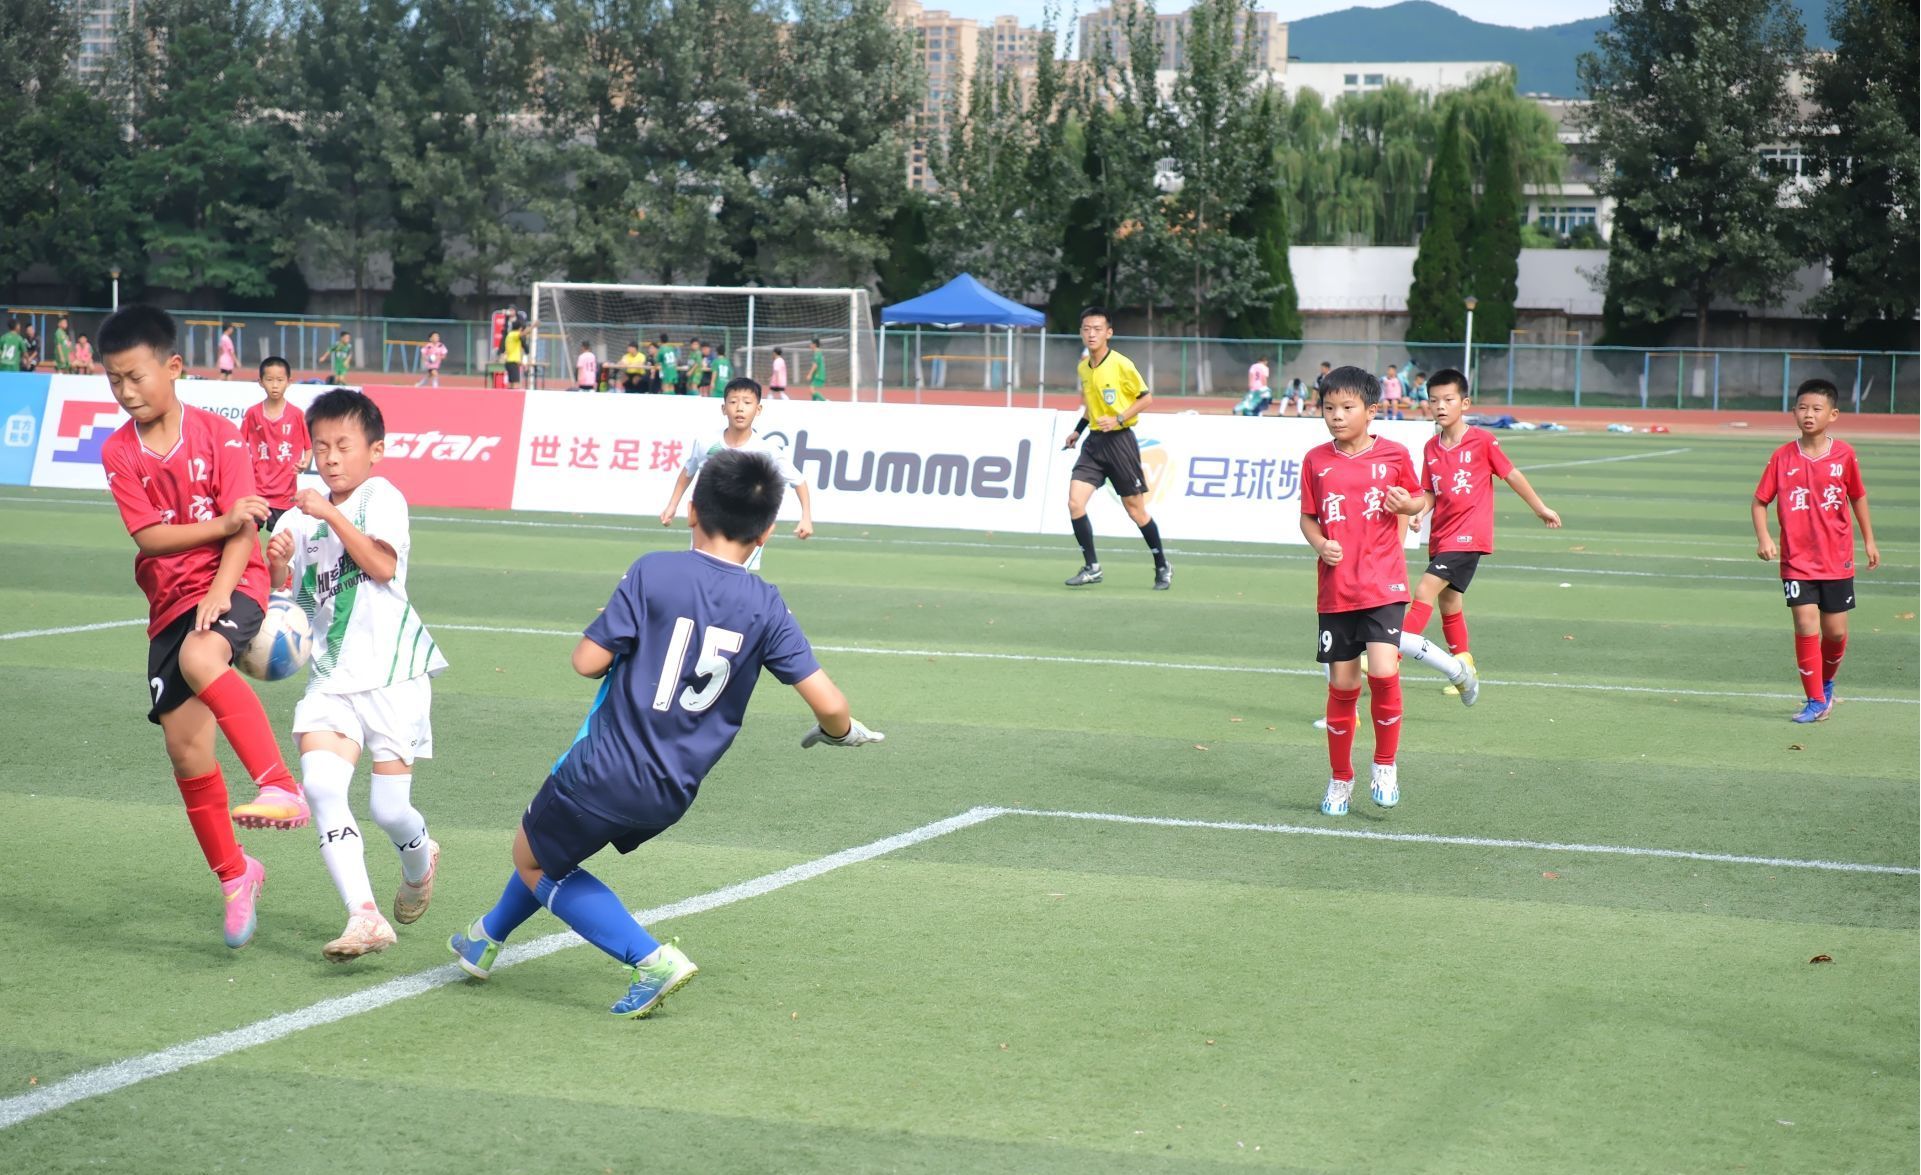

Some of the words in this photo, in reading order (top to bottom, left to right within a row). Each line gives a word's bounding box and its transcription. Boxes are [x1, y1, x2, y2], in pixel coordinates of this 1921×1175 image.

[282, 424, 292, 435] 17
[258, 440, 292, 462] 宜宾
[530, 434, 682, 472] 世达足球
[1459, 451, 1472, 464] 18
[187, 457, 208, 483] 12
[793, 429, 1031, 500] hummel
[1371, 463, 1387, 480] 19
[1829, 463, 1844, 477] 20
[1322, 486, 1386, 524] 宜宾
[1789, 484, 1843, 512] 宜宾
[1784, 580, 1801, 599] 20
[653, 616, 744, 712] 15
